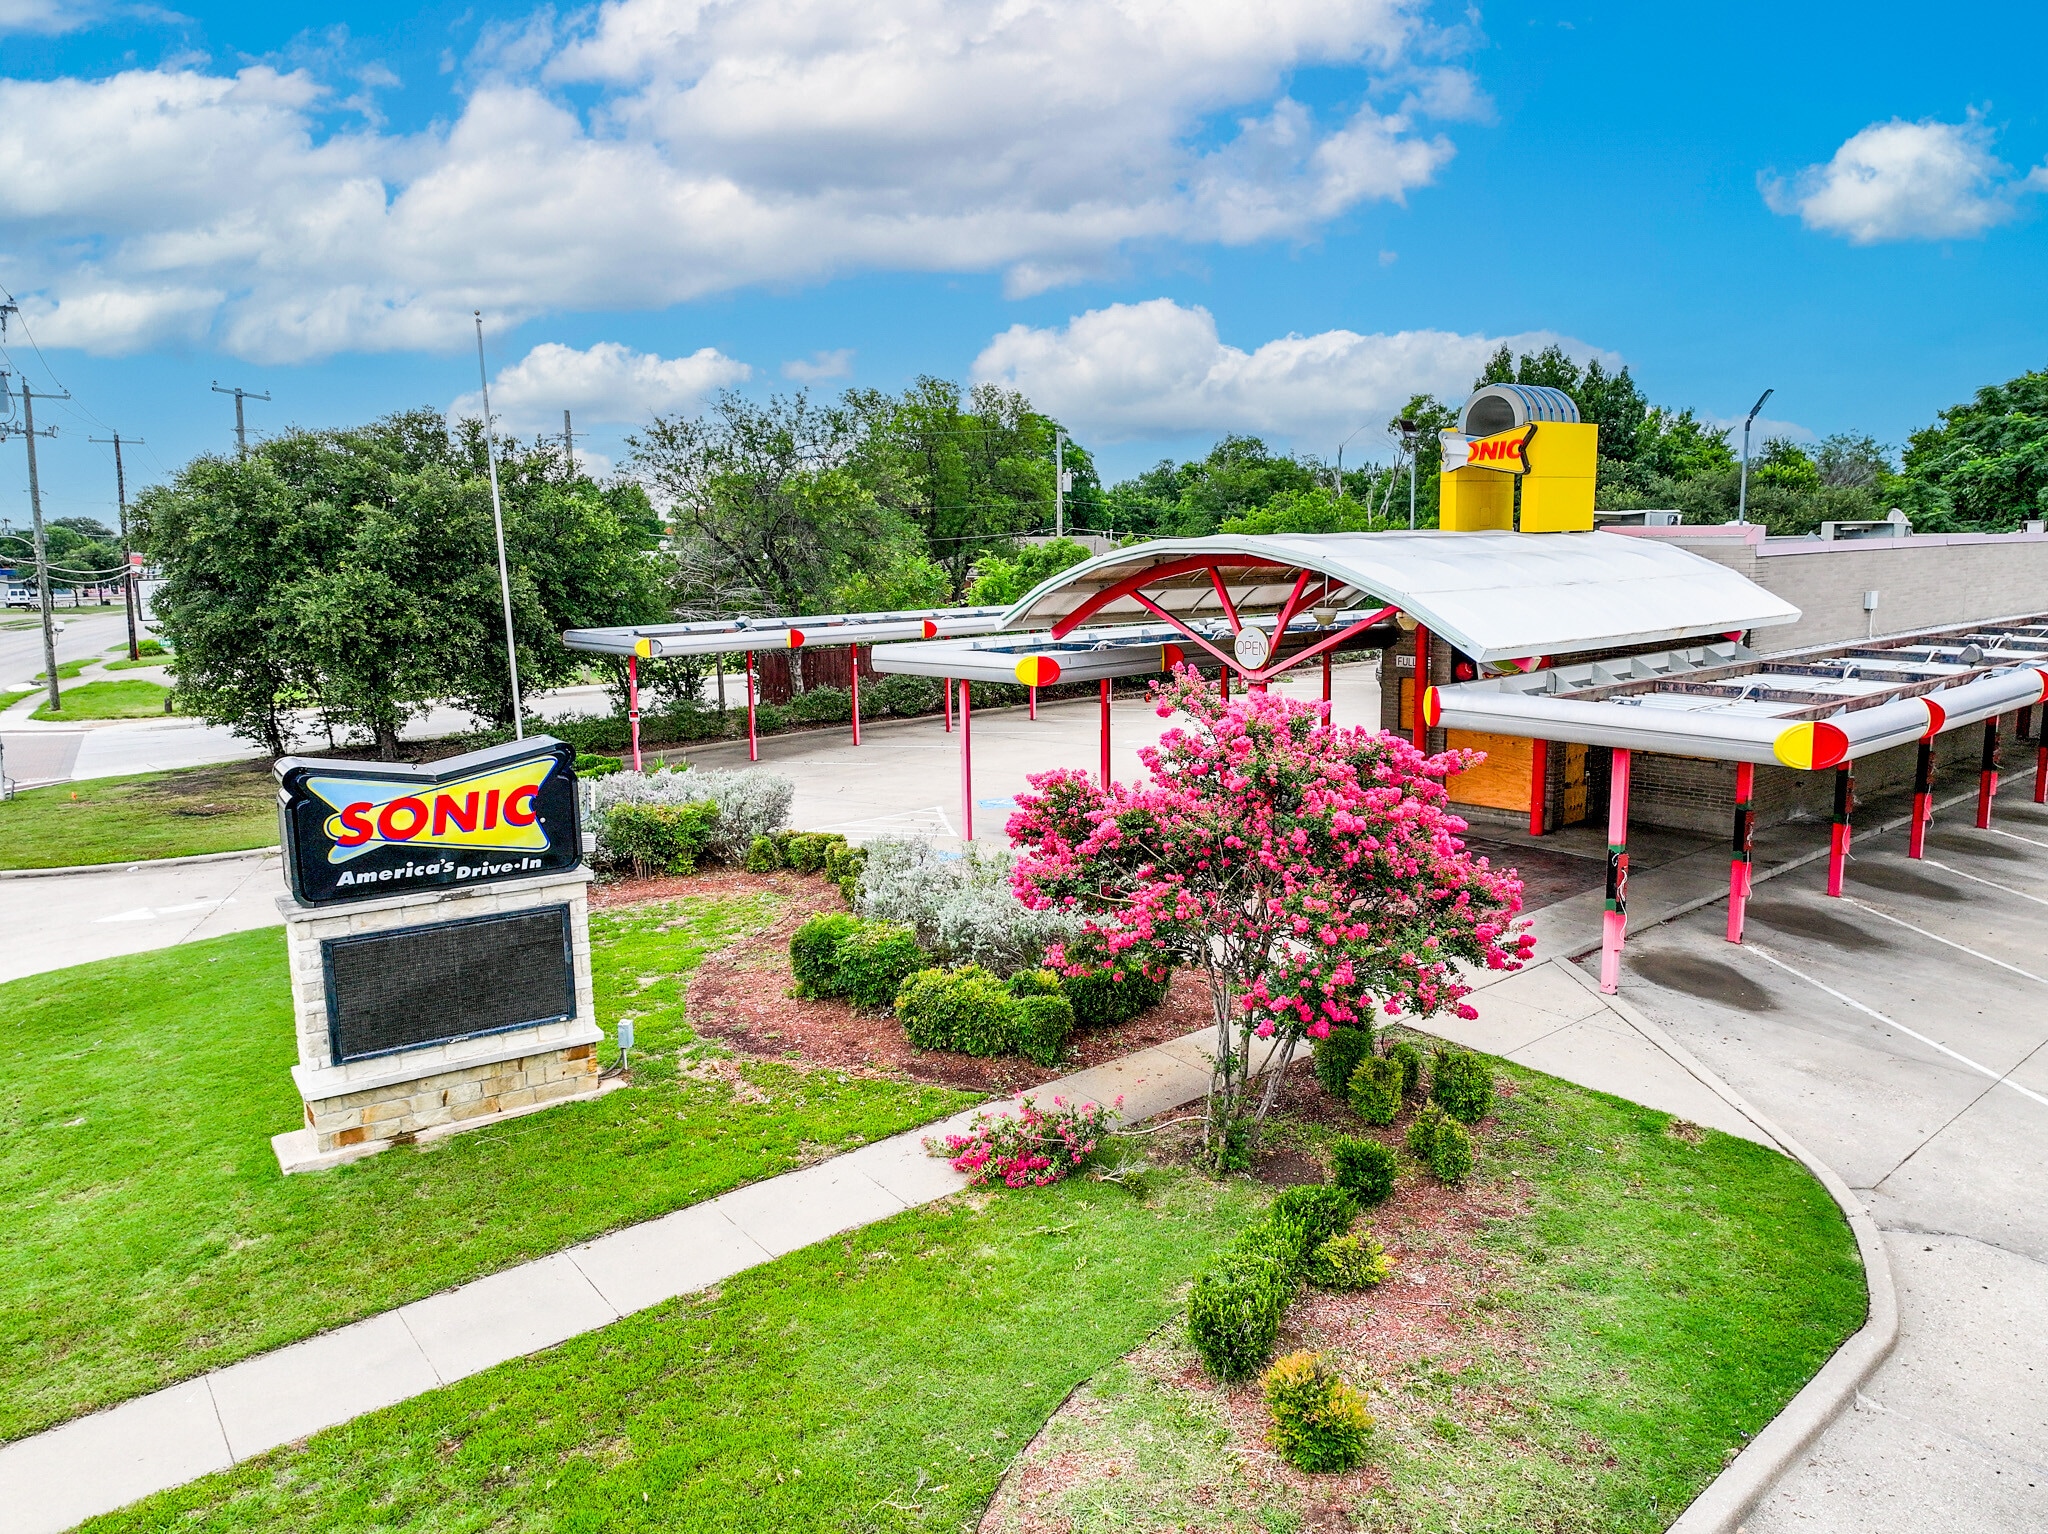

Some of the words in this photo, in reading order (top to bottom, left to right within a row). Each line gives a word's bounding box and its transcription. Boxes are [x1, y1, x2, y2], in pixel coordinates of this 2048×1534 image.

[1235, 640, 1267, 656] OPEN
[334, 785, 539, 847] SONIC
[336, 858, 455, 887] America's
